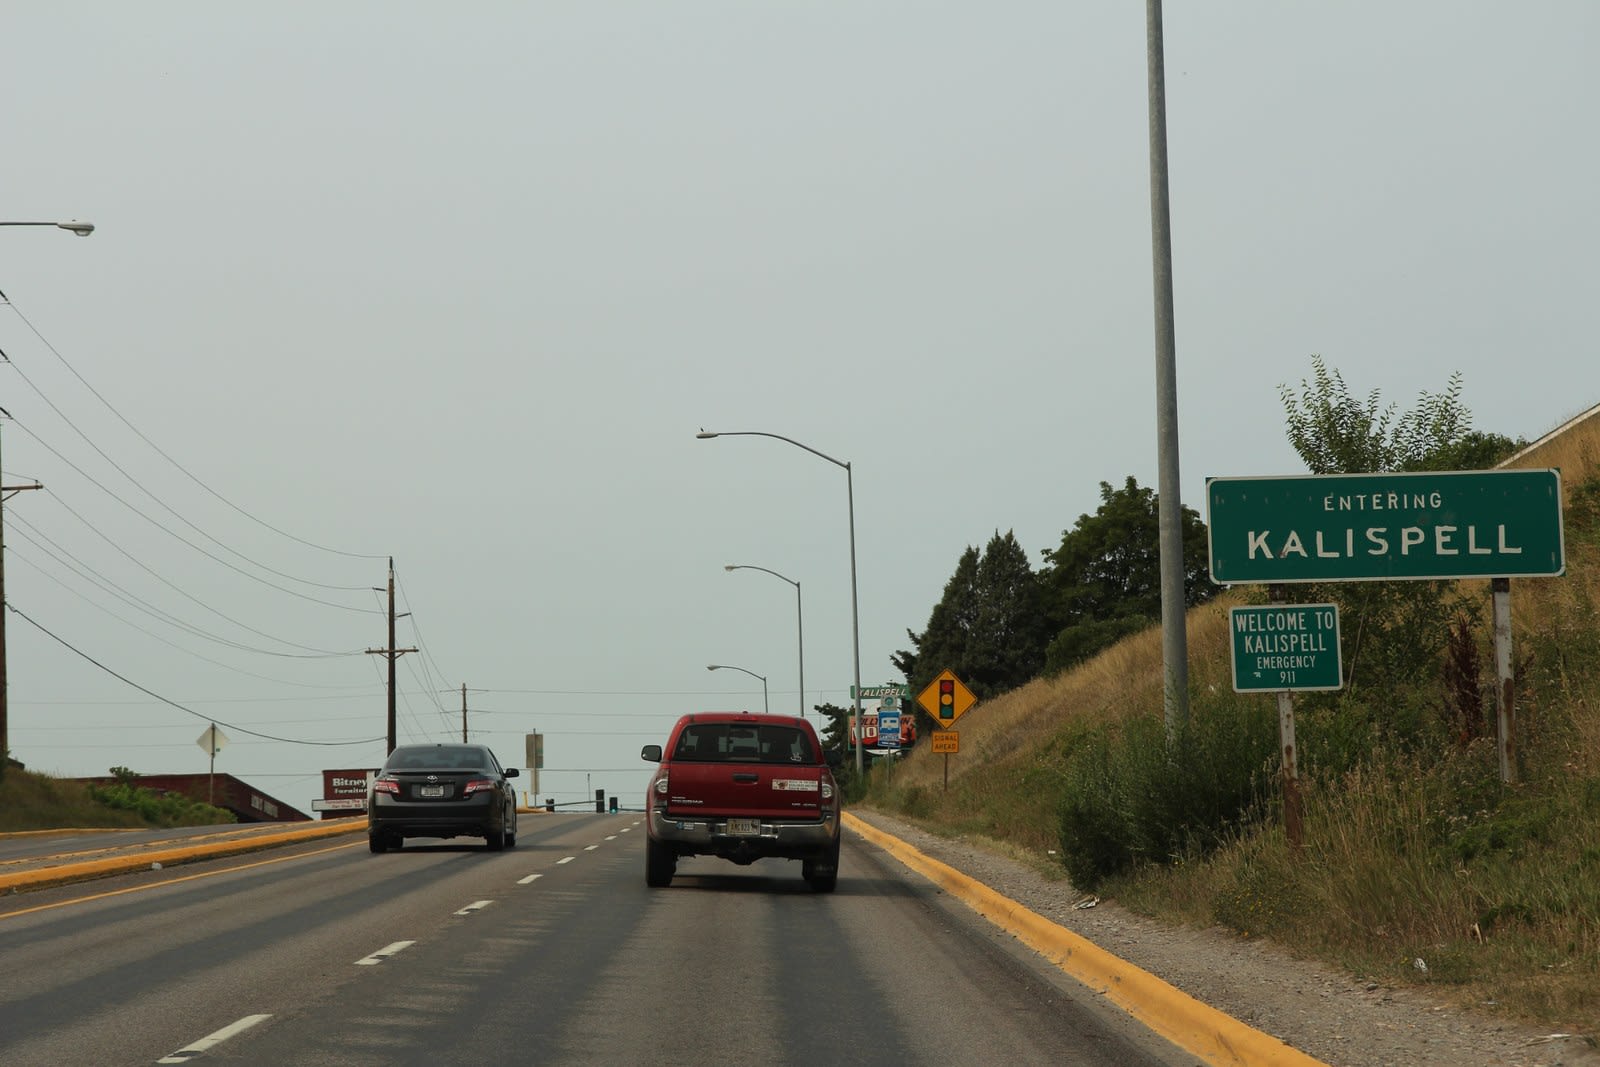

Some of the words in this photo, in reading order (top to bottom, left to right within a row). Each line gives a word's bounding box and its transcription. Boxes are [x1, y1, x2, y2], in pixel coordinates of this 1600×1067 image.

[1323, 491, 1443, 511] ENTERING
[1247, 524, 1523, 560] KALISPELL
[1235, 612, 1307, 633] WELCOME
[1315, 611, 1334, 630] TO
[1244, 633, 1328, 653] KALISPELL
[1256, 654, 1316, 669] EMERGENCY
[1280, 670, 1297, 684] 911
[332, 777, 368, 787] Bitney
